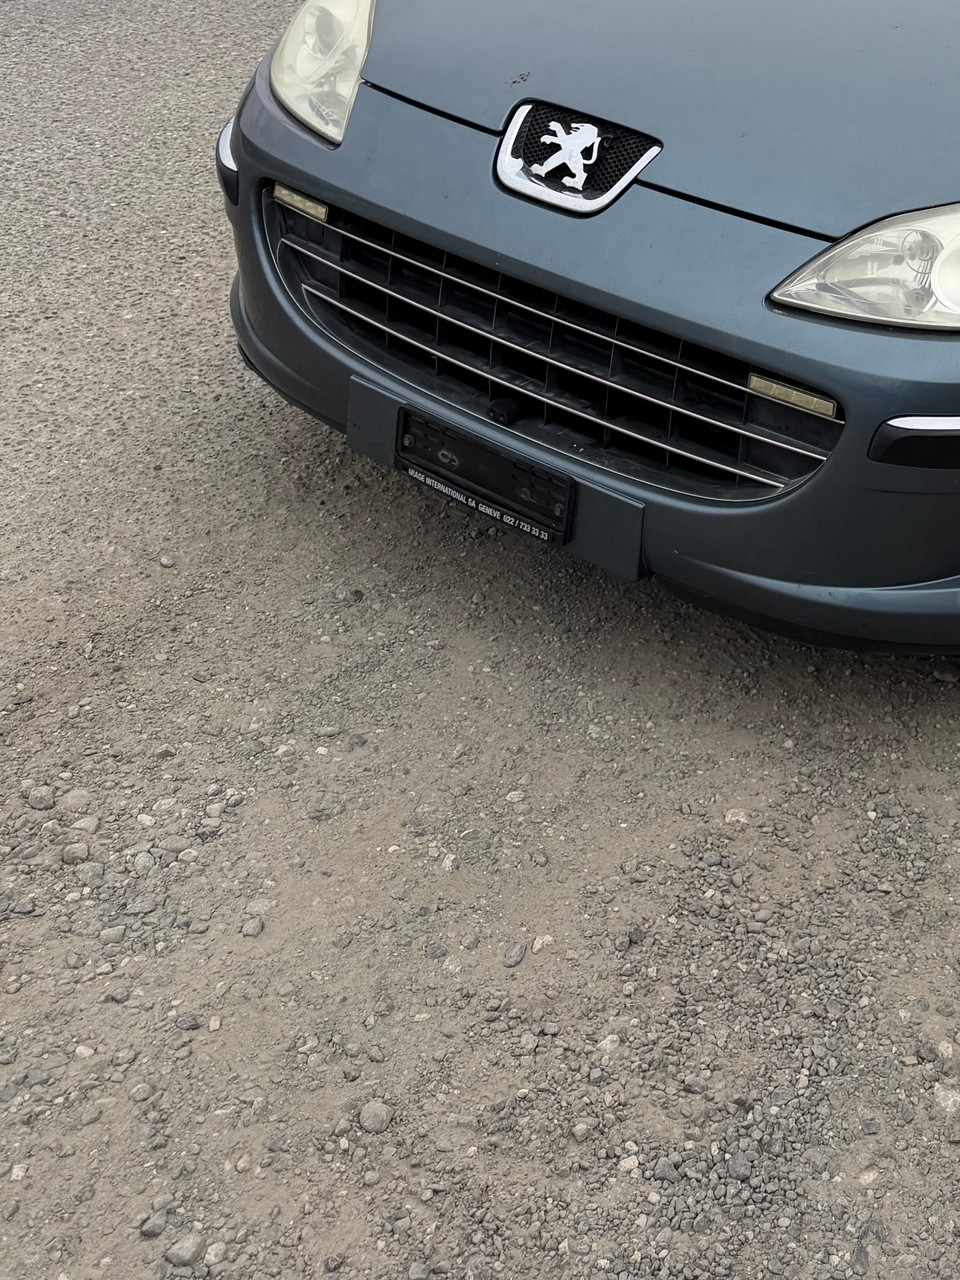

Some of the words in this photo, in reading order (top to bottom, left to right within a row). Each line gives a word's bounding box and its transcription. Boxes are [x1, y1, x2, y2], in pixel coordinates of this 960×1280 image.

[426, 477, 467, 504] INTERNATIONAL
[467, 498, 476, 508] SA
[478, 503, 501, 520] GENEVE
